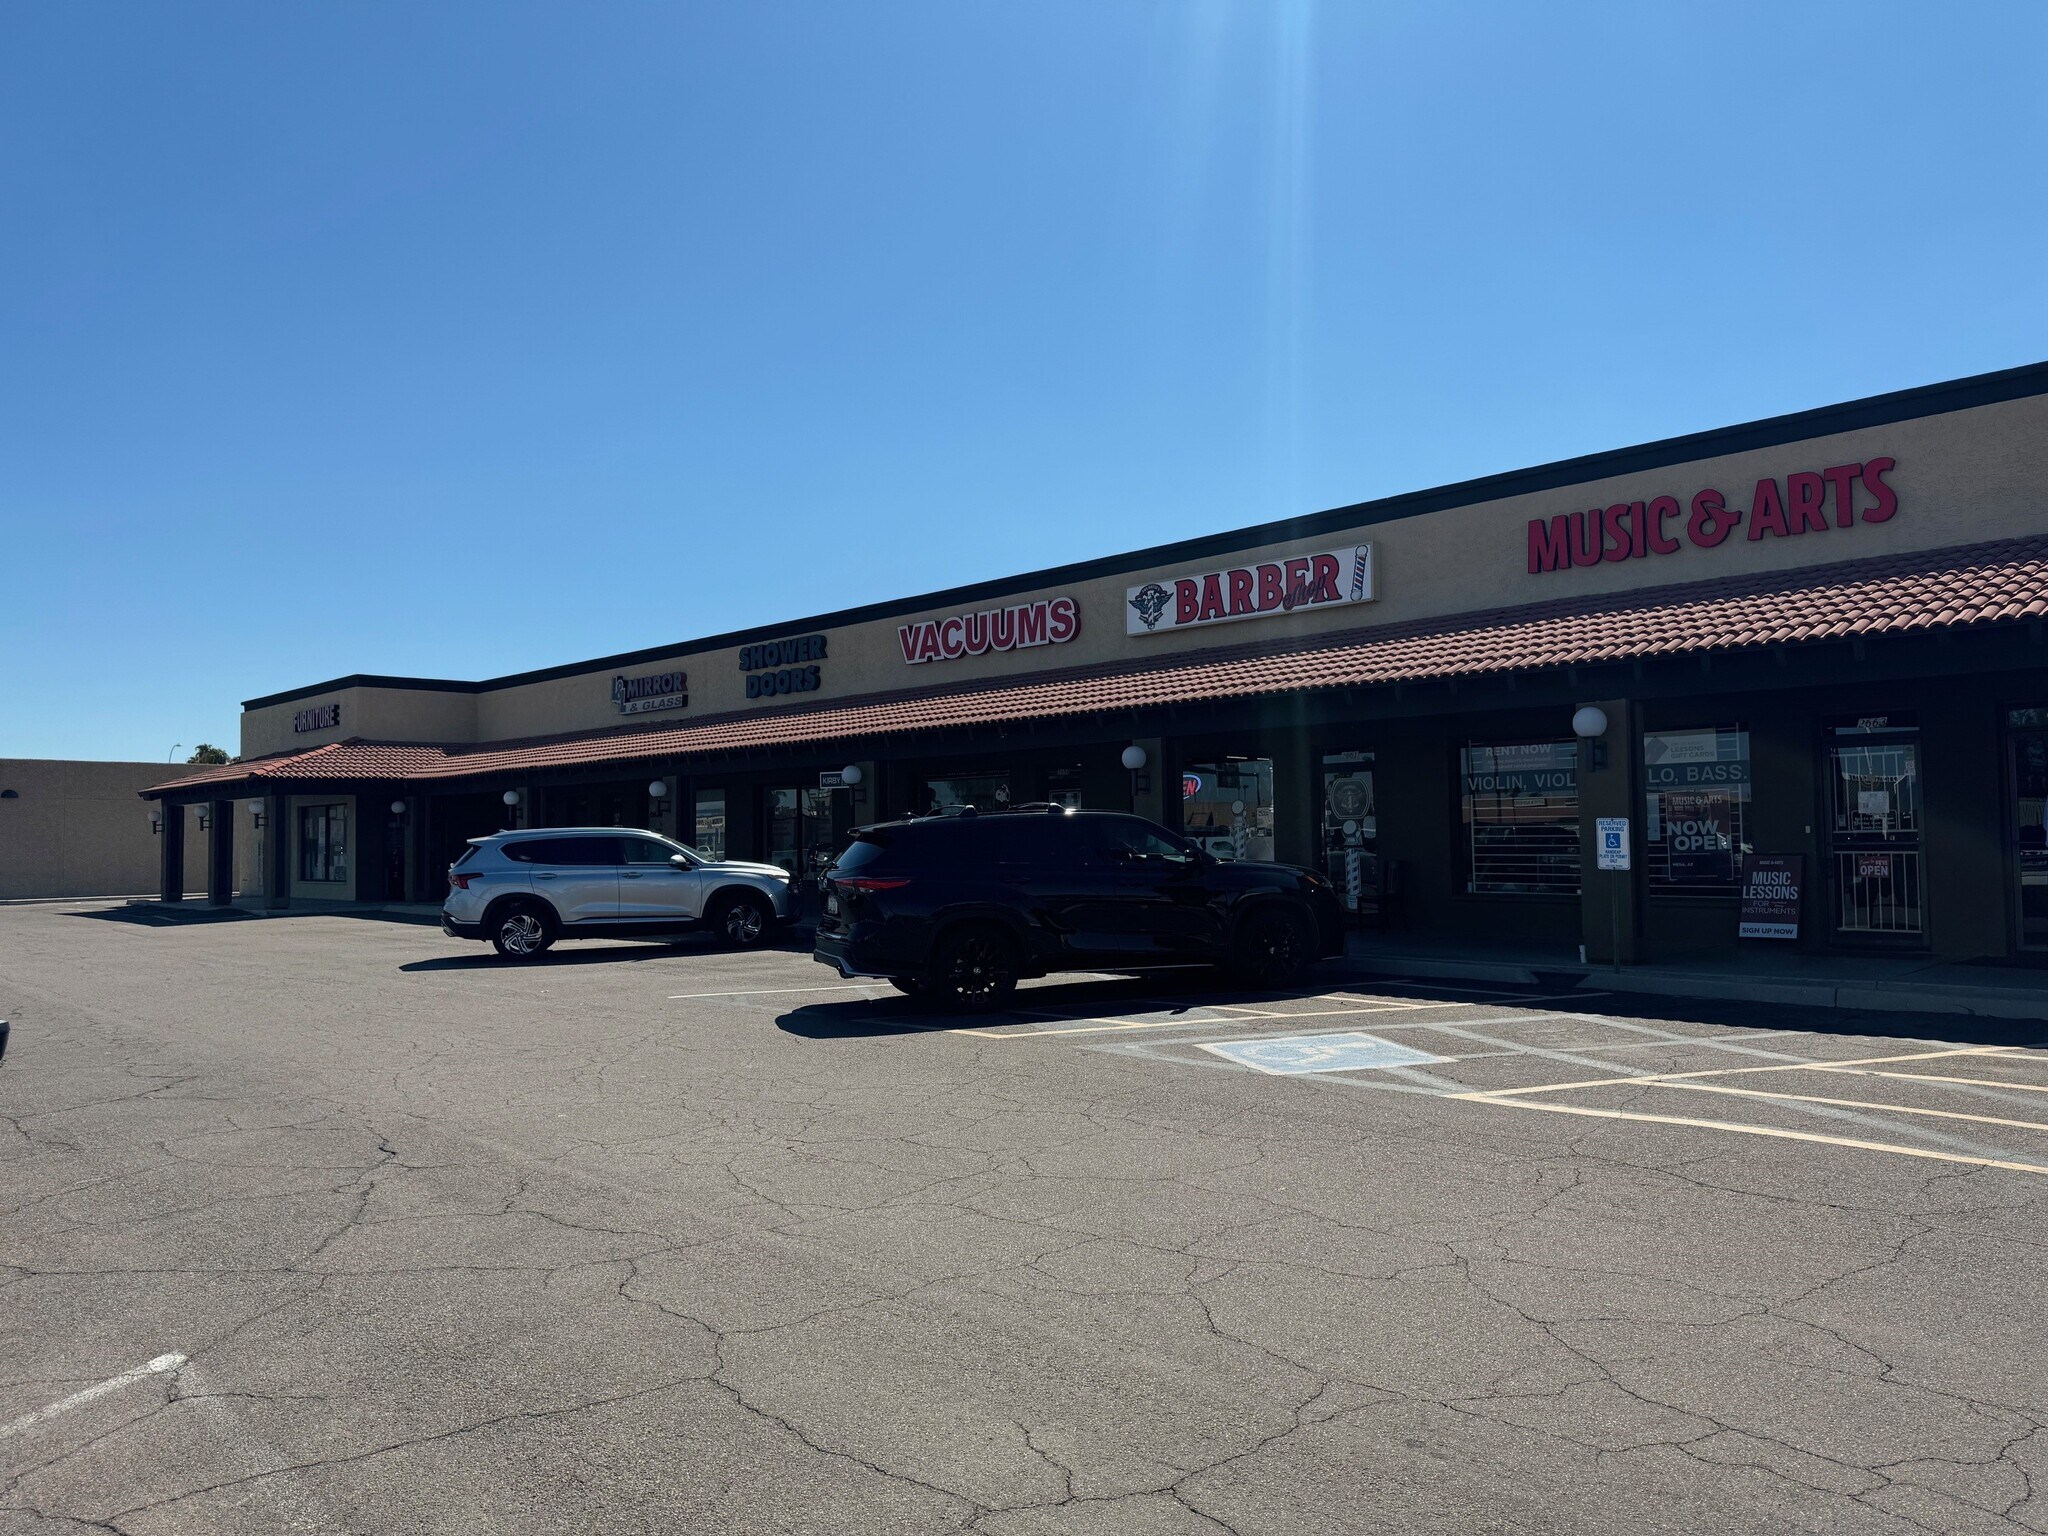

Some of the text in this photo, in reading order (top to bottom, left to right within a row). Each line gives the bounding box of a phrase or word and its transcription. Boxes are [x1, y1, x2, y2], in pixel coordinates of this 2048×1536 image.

[1527, 456, 1898, 574] MUSIC & ARTS
[1174, 553, 1343, 625] BARBER
[897, 597, 1081, 665] VACUUMS
[739, 634, 828, 671] SHOWER
[627, 672, 688, 699] MIRROR
[746, 665, 821, 698] DOORS
[629, 696, 682, 713] & GLASS
[293, 704, 339, 733] FURNITURE
[1485, 744, 1552, 757] RENT NOW
[822, 776, 841, 785] KIRBY
[1468, 772, 1577, 791] VIOLIN, VIOL
[1648, 764, 1748, 785] LO, BASS.
[1183, 779, 1197, 796] EN
[1672, 796, 1695, 806] MUSIC
[1703, 794, 1722, 804] ARTS
[1667, 820, 1719, 836] NOW
[1674, 834, 1732, 851] OPEN
[1752, 871, 1792, 885] MUSIC
[1860, 865, 1889, 876] OPEN
[1742, 885, 1799, 900] LESSONS
[1742, 906, 1796, 915] INSTRUMENTS
